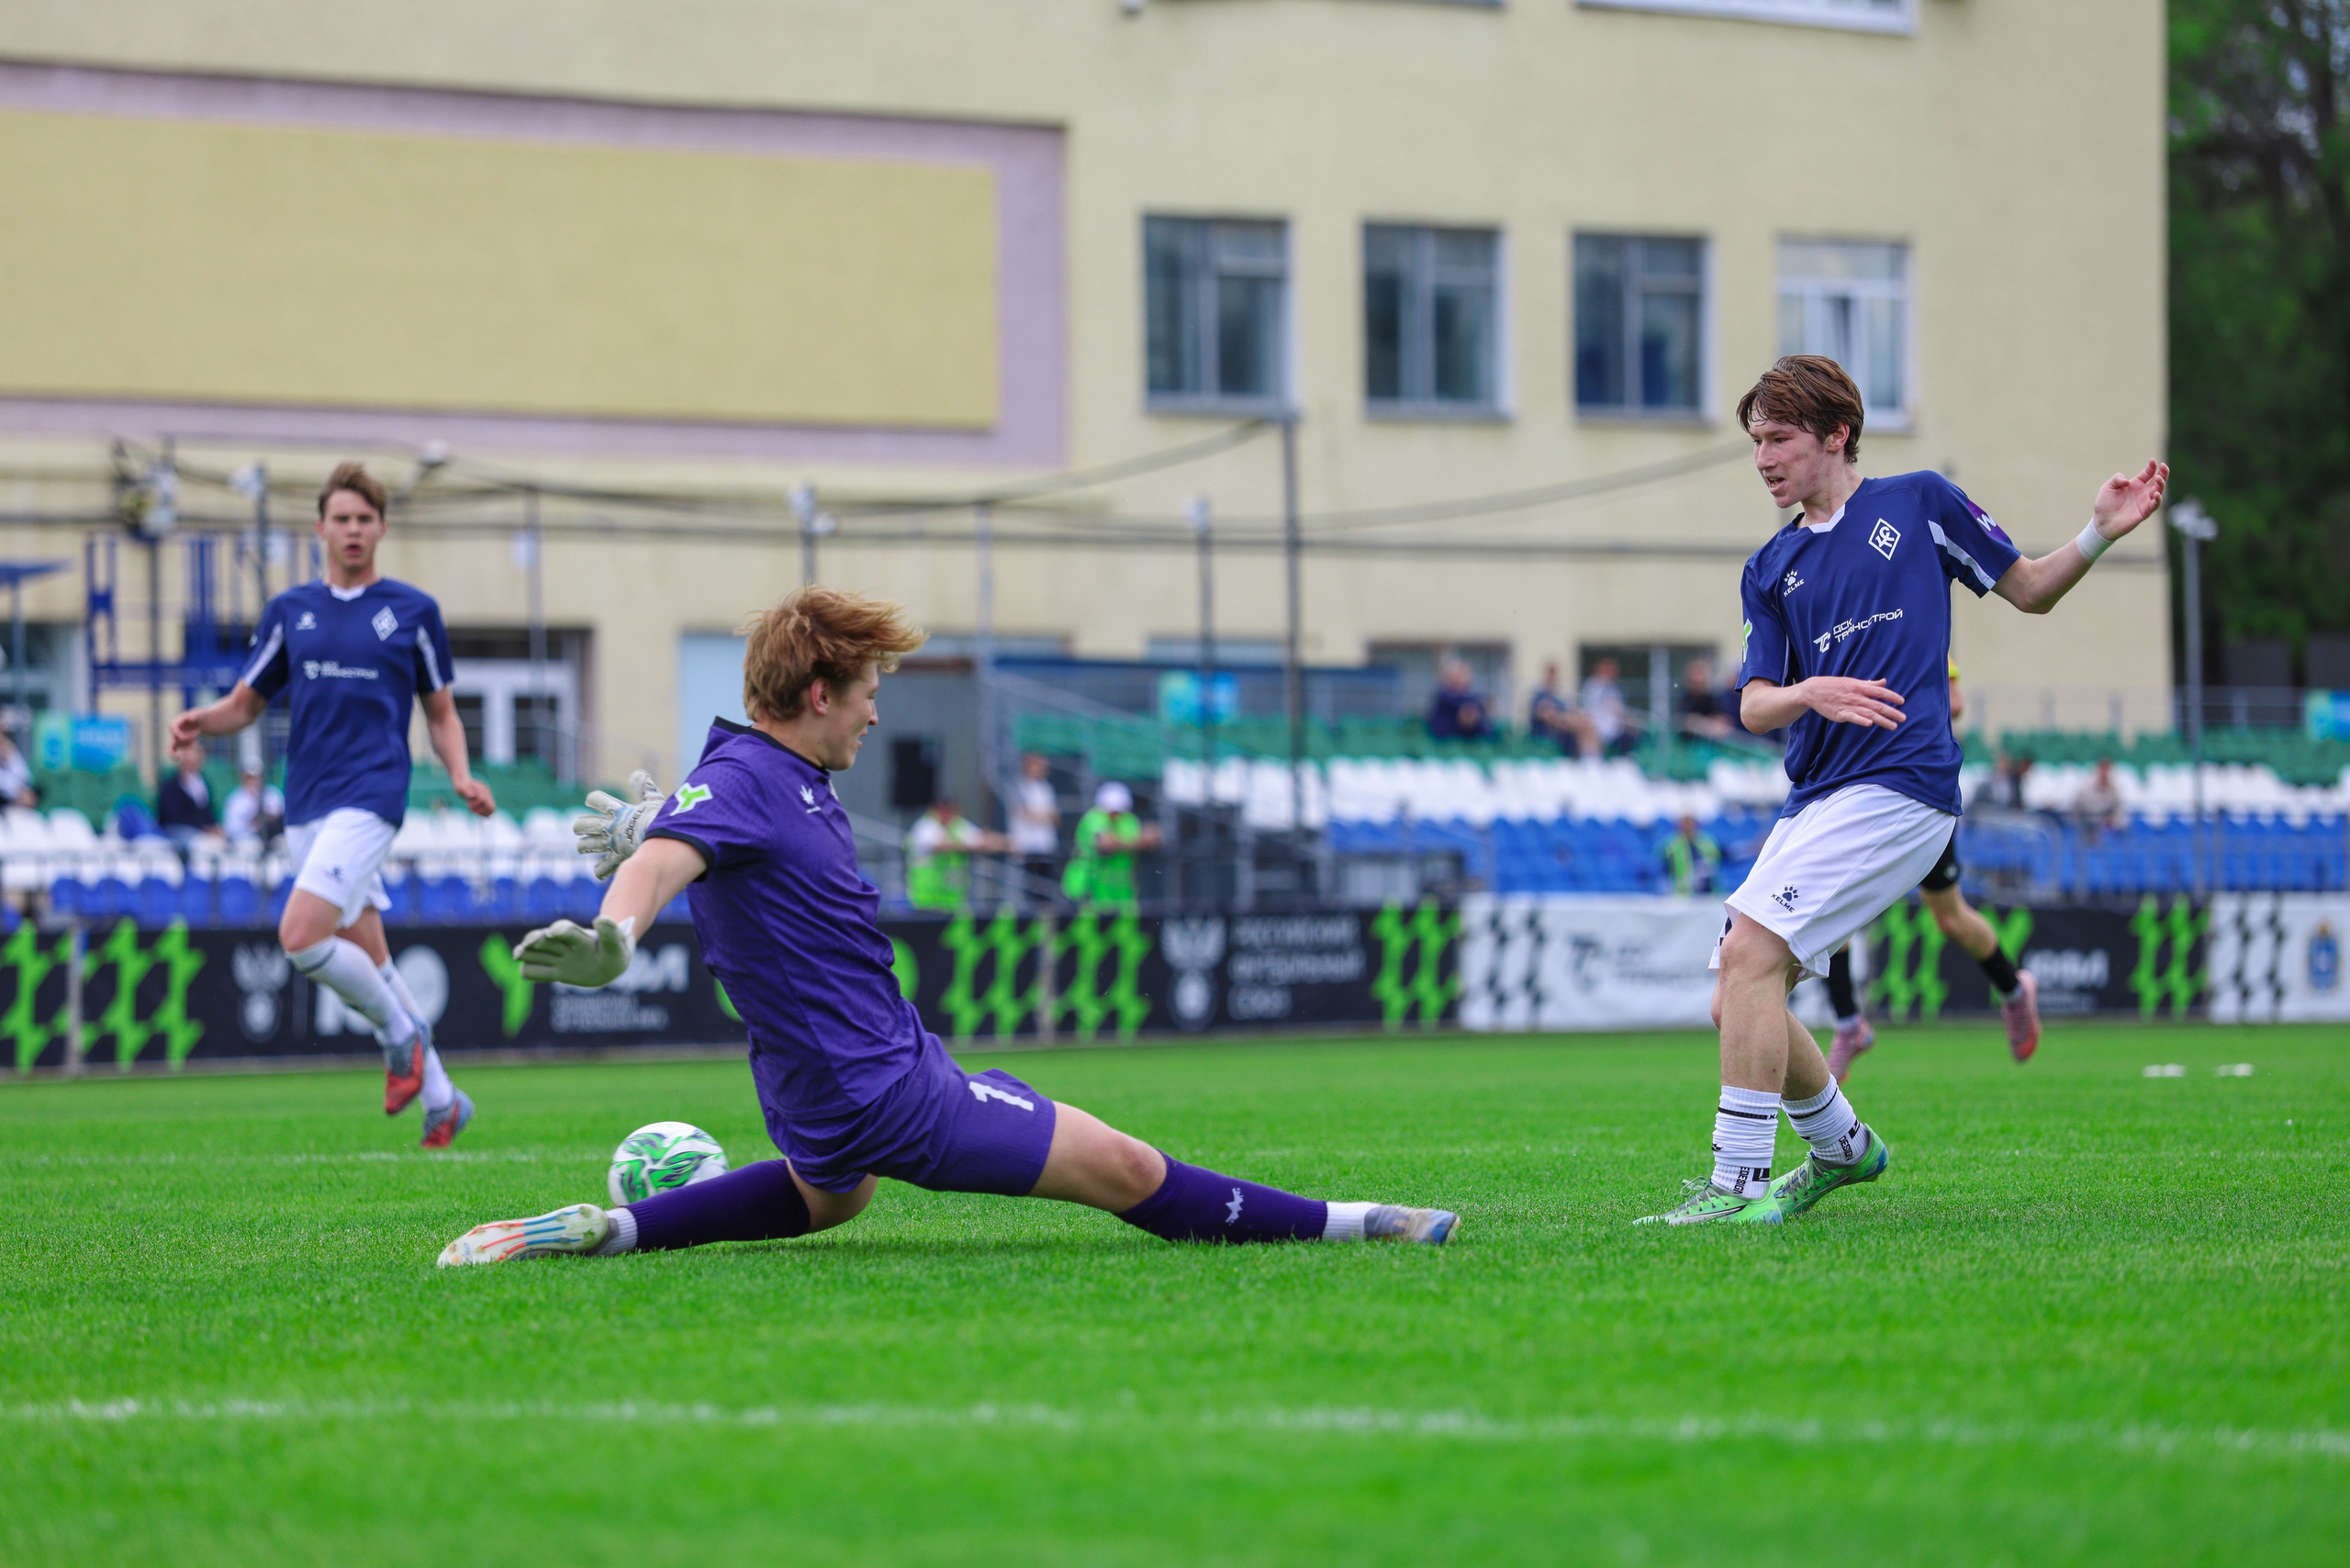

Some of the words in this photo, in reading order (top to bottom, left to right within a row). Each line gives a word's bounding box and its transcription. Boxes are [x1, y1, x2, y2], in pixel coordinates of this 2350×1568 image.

[1784, 578, 1805, 597] KELME
[1771, 893, 1796, 913] KELME
[968, 1081, 1035, 1112] 1
